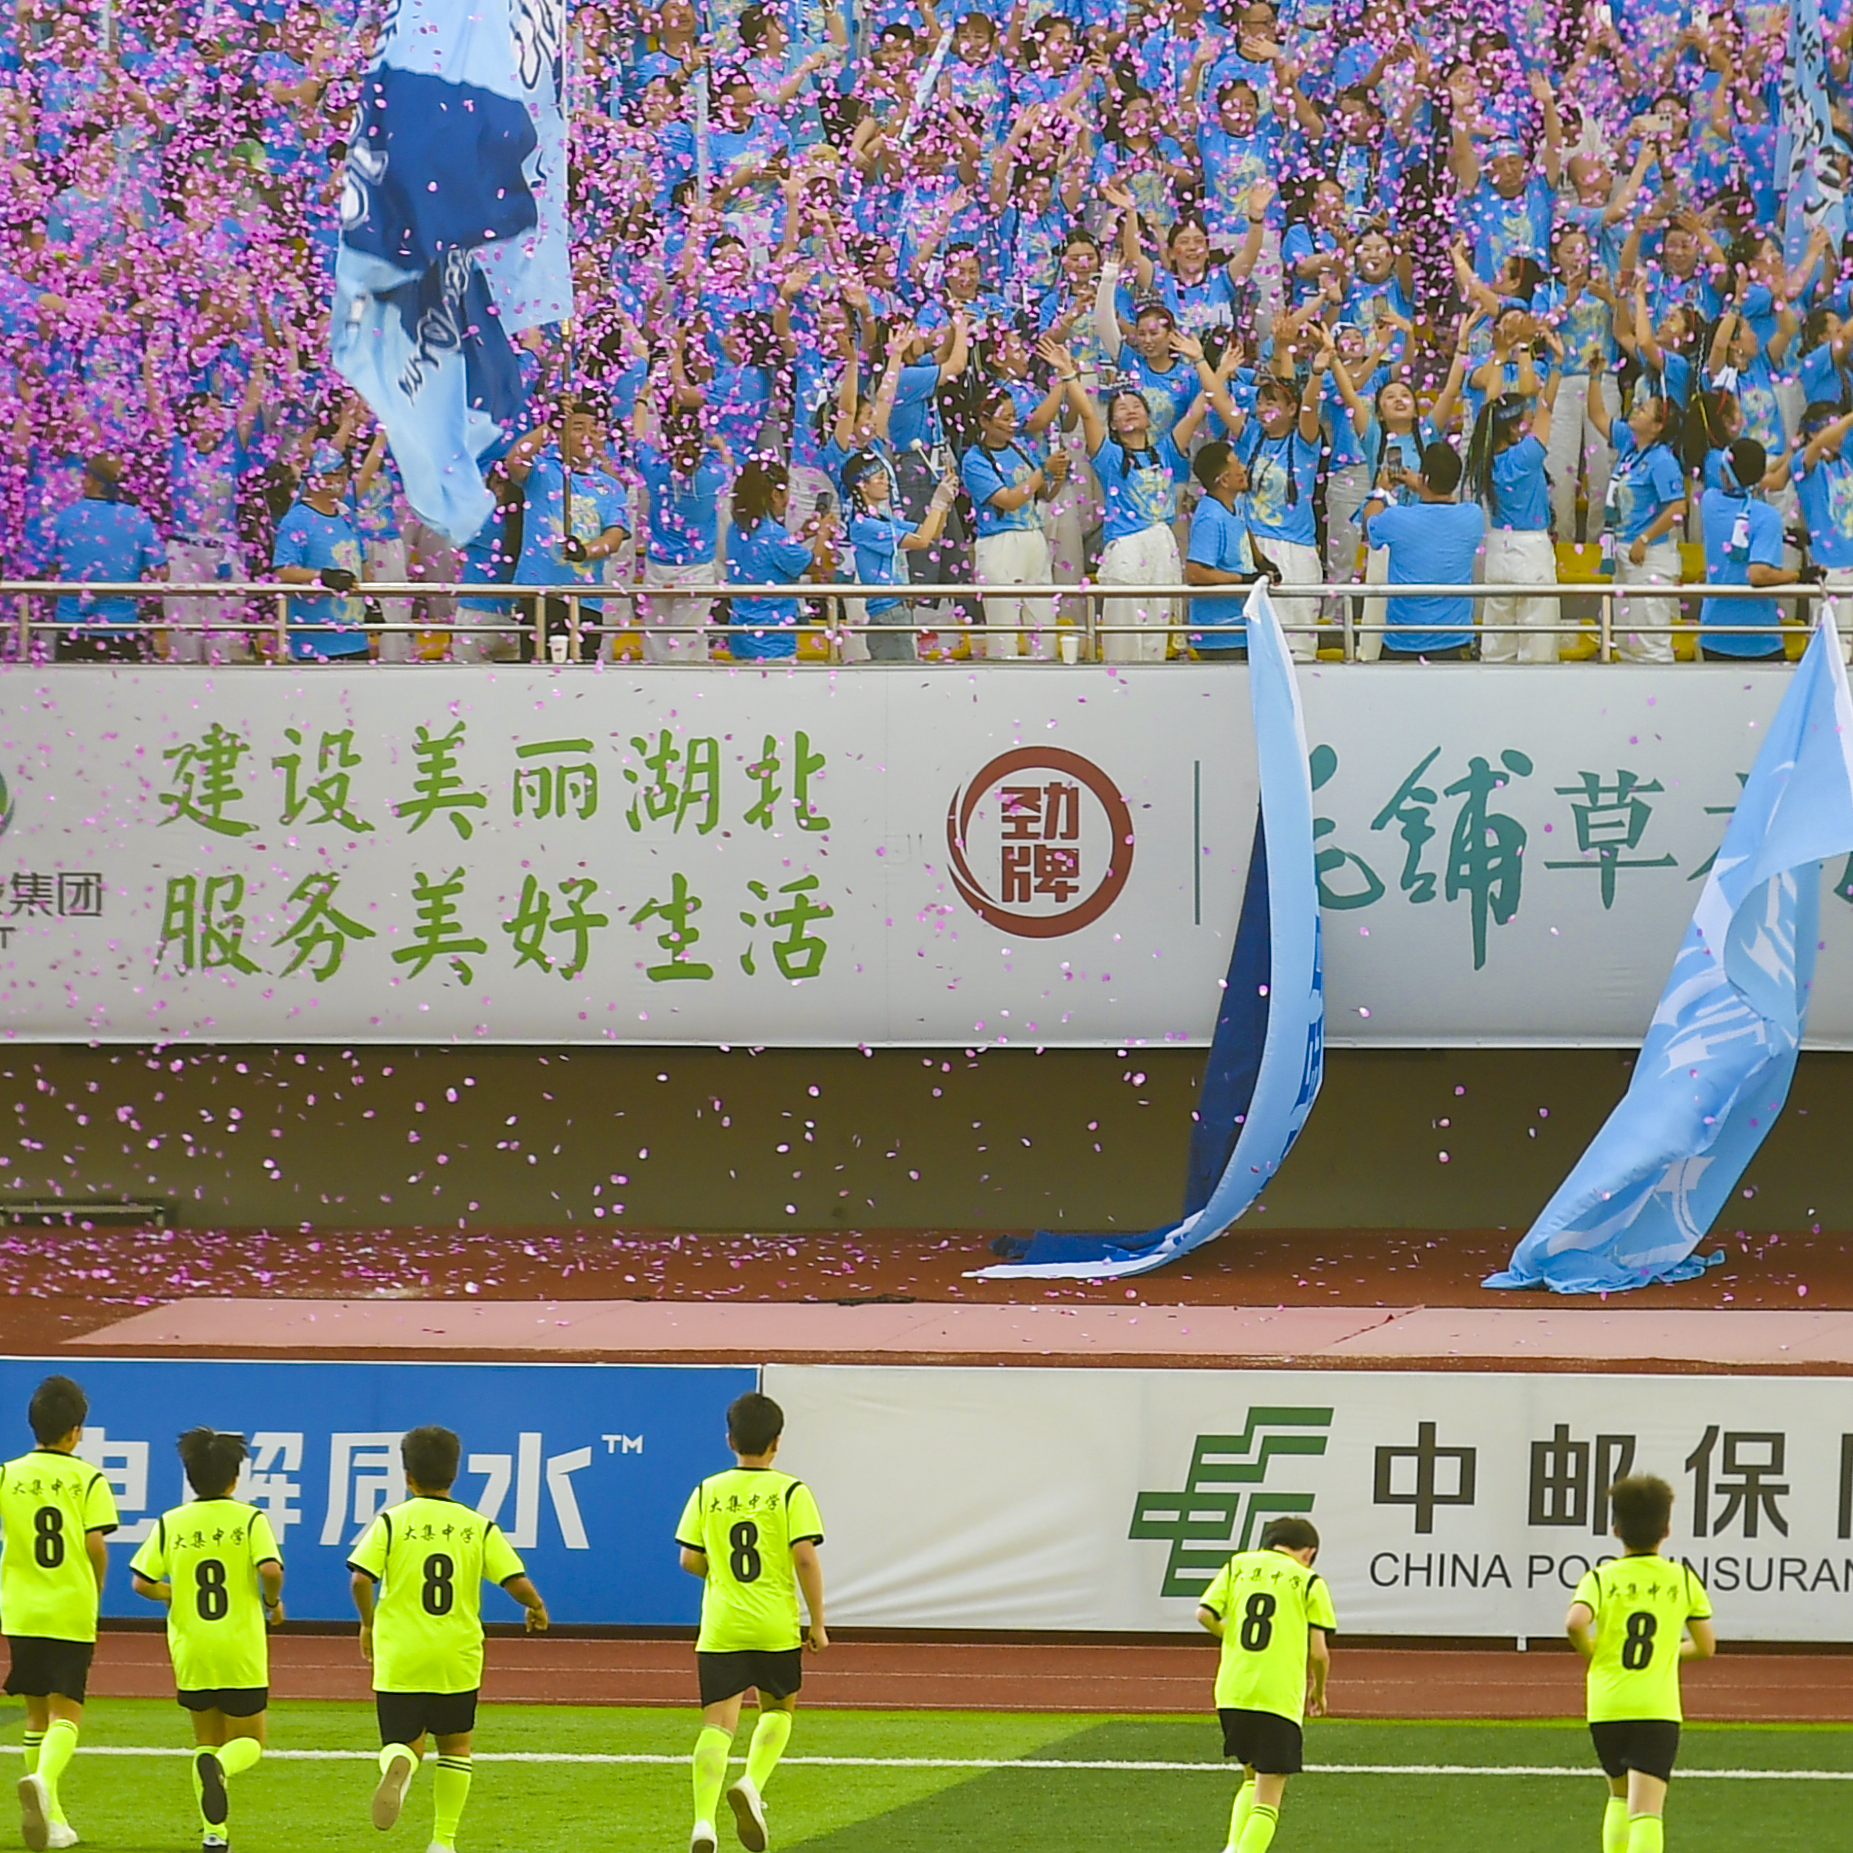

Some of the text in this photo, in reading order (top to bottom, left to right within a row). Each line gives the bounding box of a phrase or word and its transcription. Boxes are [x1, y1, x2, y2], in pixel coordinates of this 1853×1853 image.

[157, 720, 833, 841] 建设美丽湖北
[154, 871, 835, 987] 服务美好生活
[34, 1506, 65, 1569] 8
[730, 1520, 762, 1584] 8
[195, 1559, 229, 1622] 8
[421, 1553, 455, 1617] 8
[1370, 1552, 1513, 1588] CHINA
[1240, 1592, 1277, 1653] 8
[1621, 1611, 1658, 1671] 8
